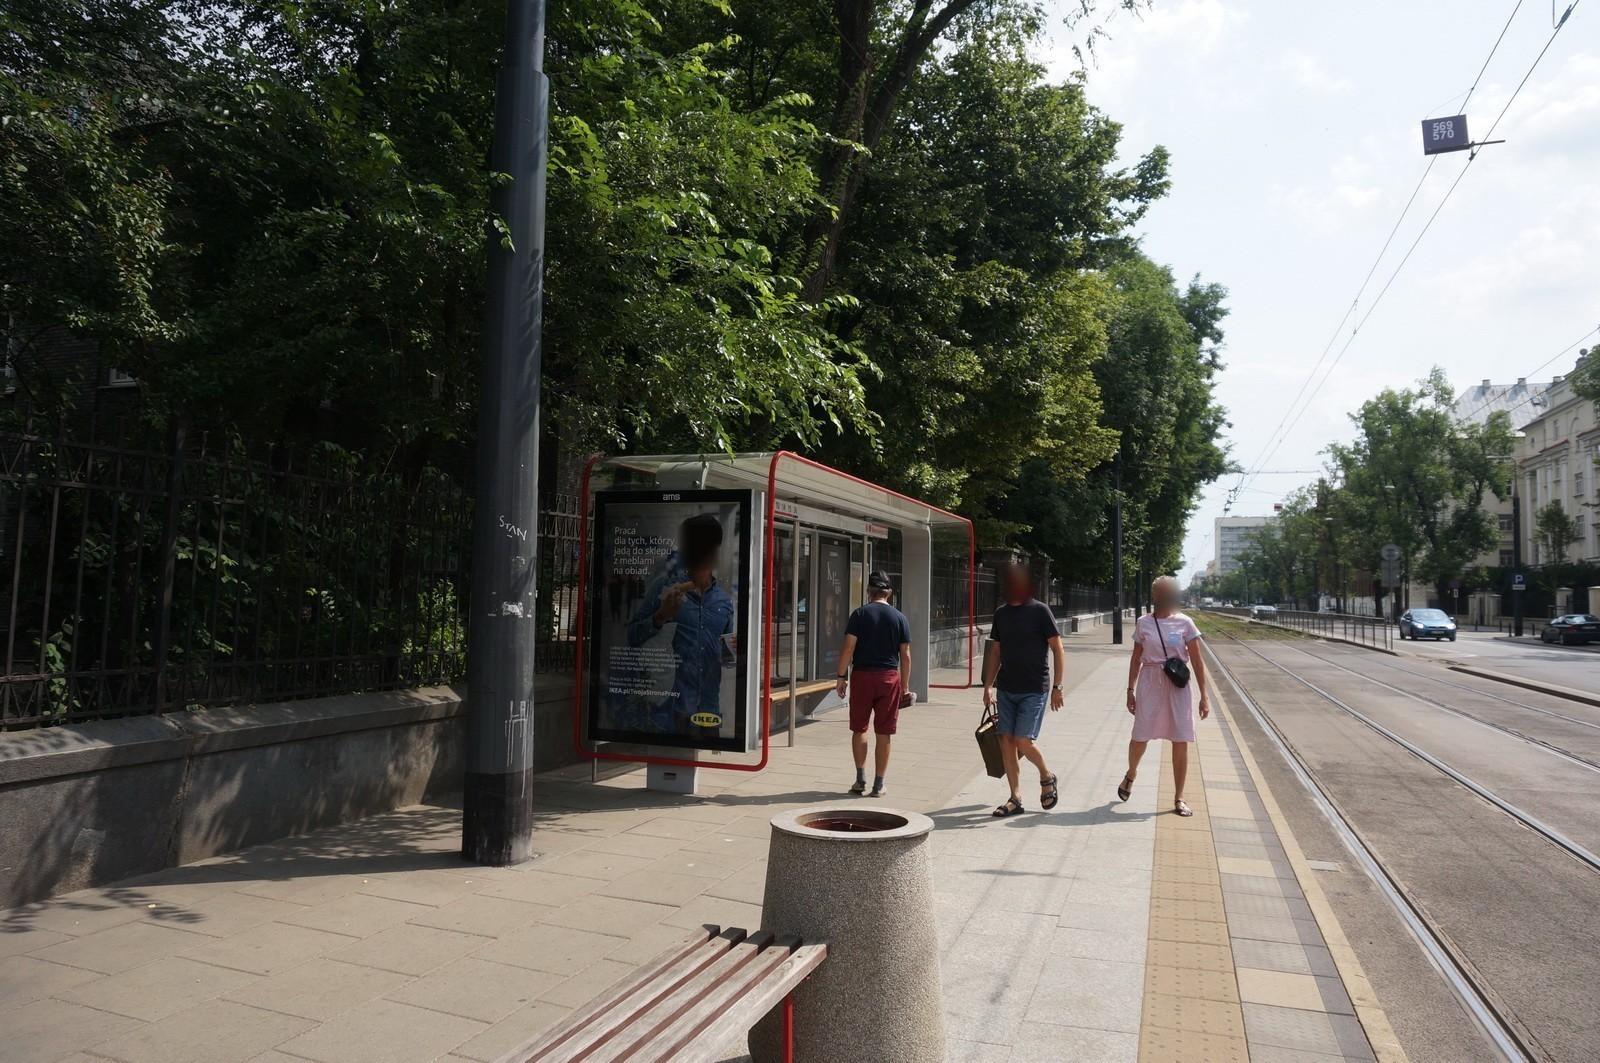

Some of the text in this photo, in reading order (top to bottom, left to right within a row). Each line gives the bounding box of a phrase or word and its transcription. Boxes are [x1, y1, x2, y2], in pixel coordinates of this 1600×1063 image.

[1433, 121, 1453, 132] 569
[1433, 130, 1454, 140] 570
[614, 526, 636, 535] Praca
[614, 535, 675, 547] dla tych, którzy
[613, 546, 672, 557] jadą do sklepu
[613, 556, 655, 565] z meblami
[613, 566, 651, 575] na obiad.
[1515, 575, 1523, 583] P
